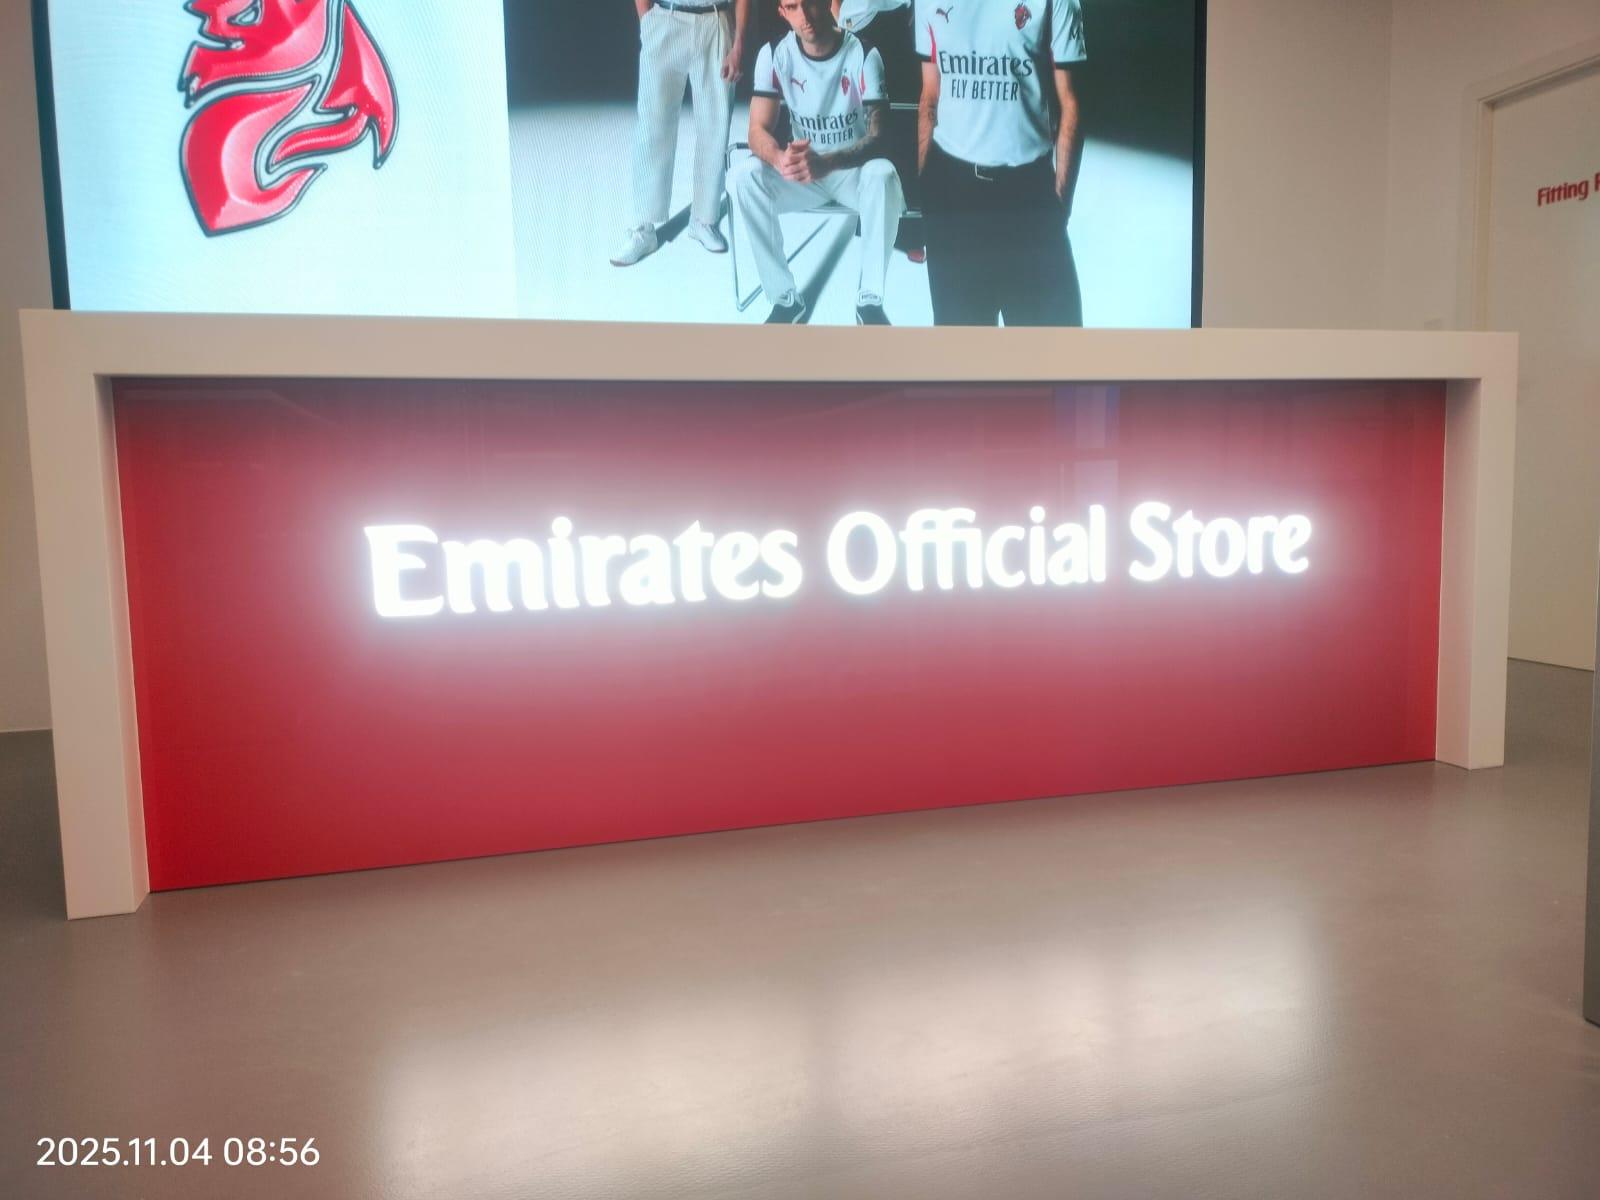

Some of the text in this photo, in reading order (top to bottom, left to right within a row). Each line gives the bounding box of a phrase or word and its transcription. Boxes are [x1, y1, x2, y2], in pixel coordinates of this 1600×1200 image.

[939, 50, 1033, 77] Emirates
[951, 79, 1019, 102] FLY BETTER
[820, 127, 854, 145] BETTER
[1537, 180, 1589, 207] Fitting
[363, 500, 1313, 617] Emirates Official Store
